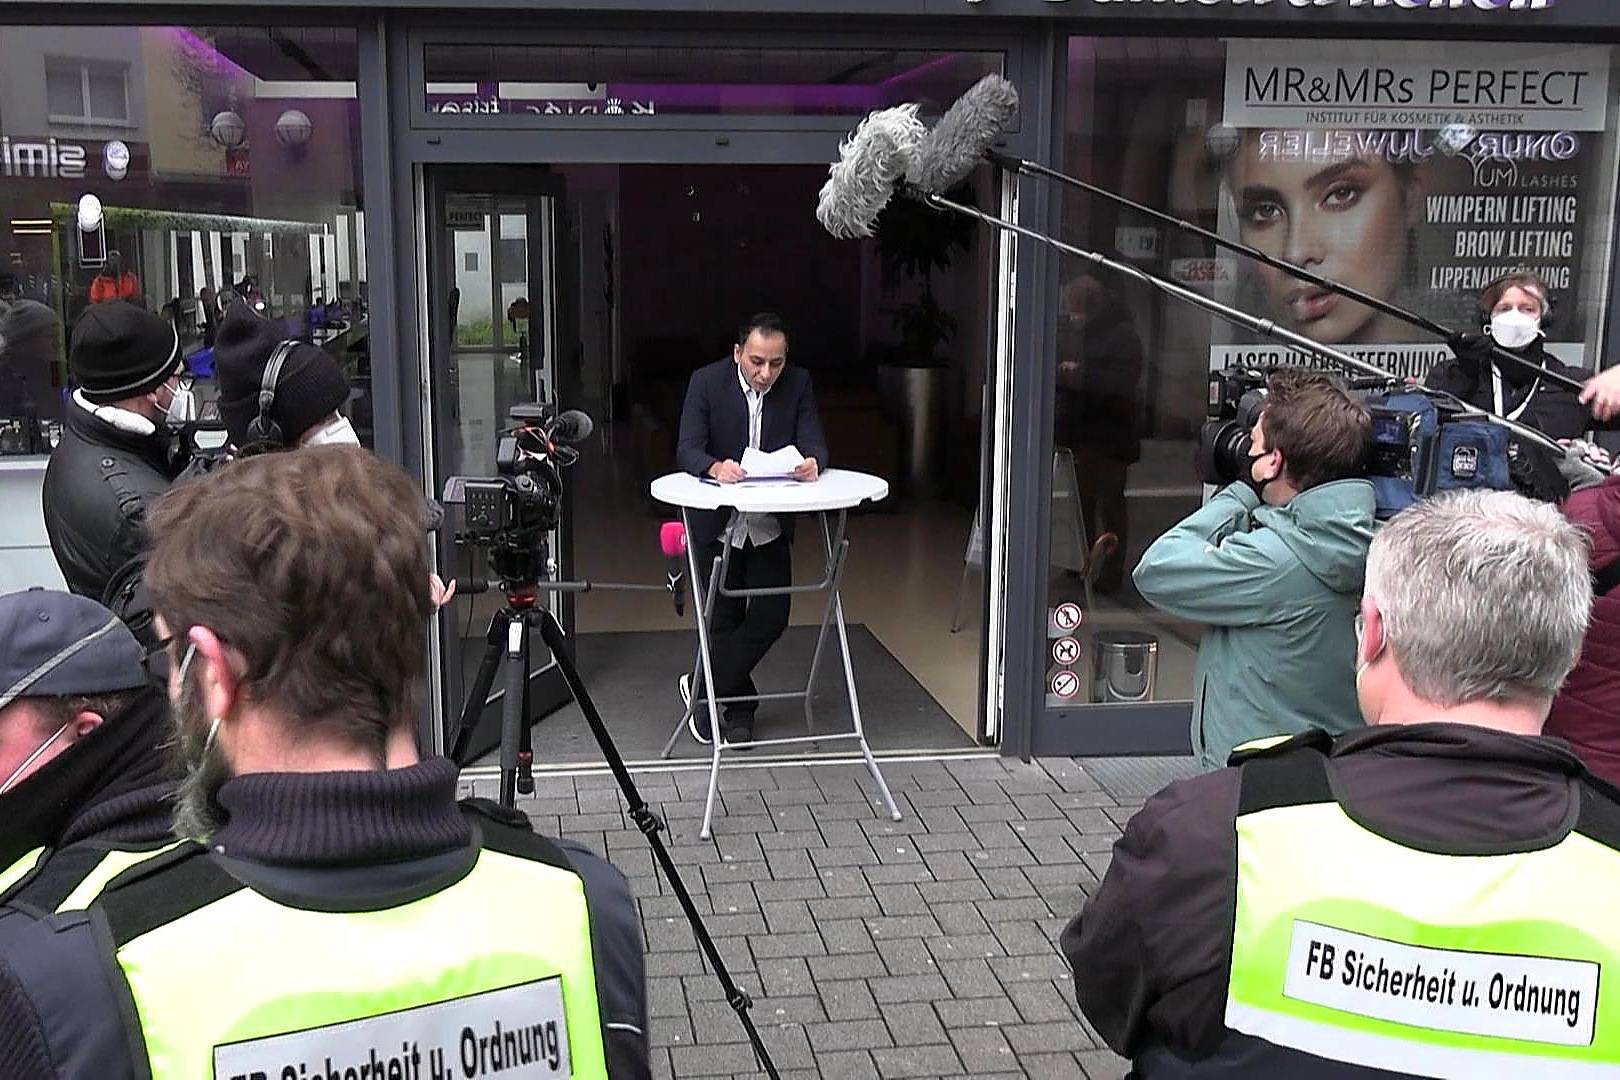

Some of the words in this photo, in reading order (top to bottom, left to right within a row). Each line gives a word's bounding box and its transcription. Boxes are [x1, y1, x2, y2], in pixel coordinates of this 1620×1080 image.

[1244, 66, 1414, 103] MR&MRs
[1429, 69, 1589, 105] PERFECT
[1306, 111, 1359, 124] INSTITUT
[1364, 111, 1386, 125] FÜR
[1391, 112, 1451, 125] KOSMETIK
[1521, 175, 1578, 188] LASHES
[1426, 195, 1507, 224] WIMPERN
[1511, 196, 1577, 224] LIFTING
[1455, 230, 1506, 258] BROW
[1508, 230, 1573, 258] LIFTING
[1430, 262, 1571, 289] LIPPENAUUNG
[1306, 940, 1336, 981] FB
[1341, 950, 1456, 1006] Sicherheit
[1461, 980, 1480, 1008] u.
[1488, 972, 1581, 1028] Ordnung
[280, 1041, 421, 1080] iherheit
[460, 1019, 558, 1080] Ordnung
